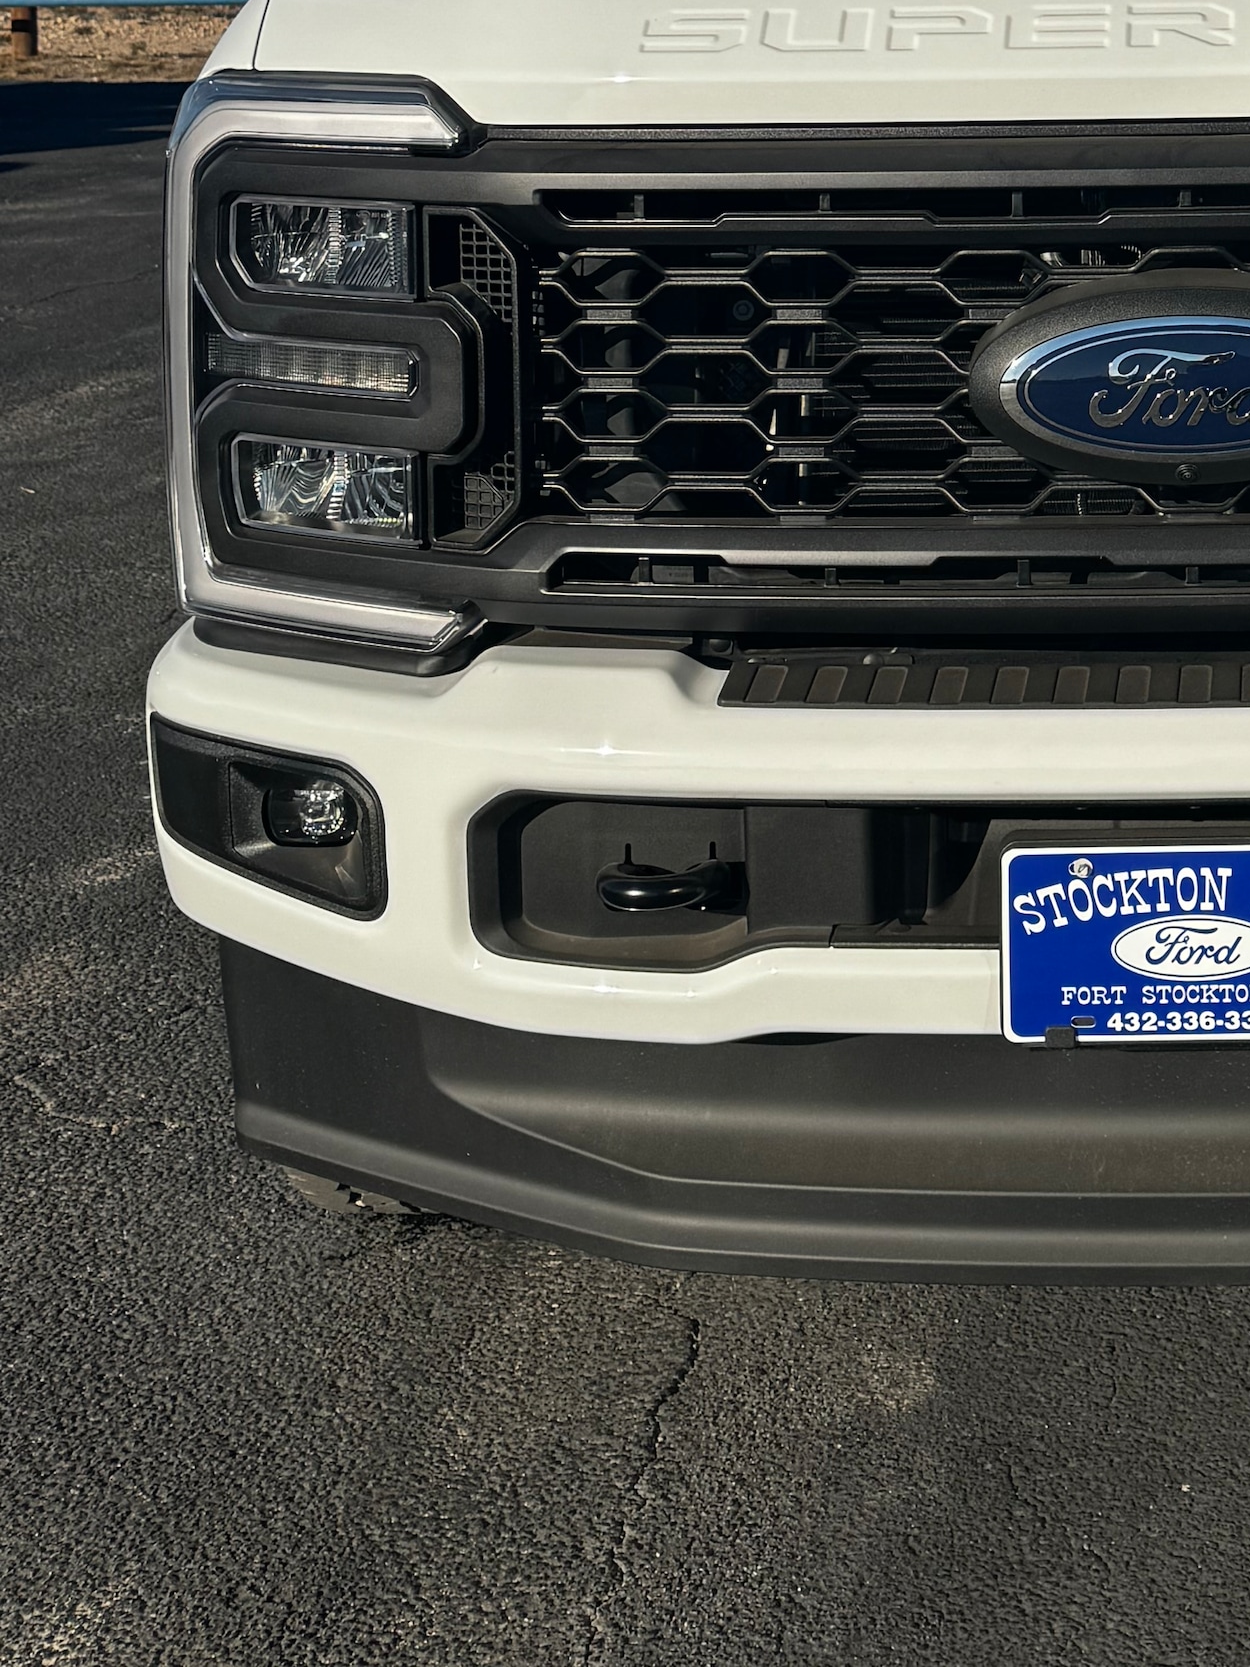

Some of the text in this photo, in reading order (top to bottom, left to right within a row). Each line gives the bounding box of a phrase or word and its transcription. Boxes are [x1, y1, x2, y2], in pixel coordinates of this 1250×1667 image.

[639, 3, 1235, 53] SUPER
[1013, 867, 1233, 935] STOCKTON
[1145, 926, 1242, 965] Ford
[1061, 986, 1127, 1005] FORT
